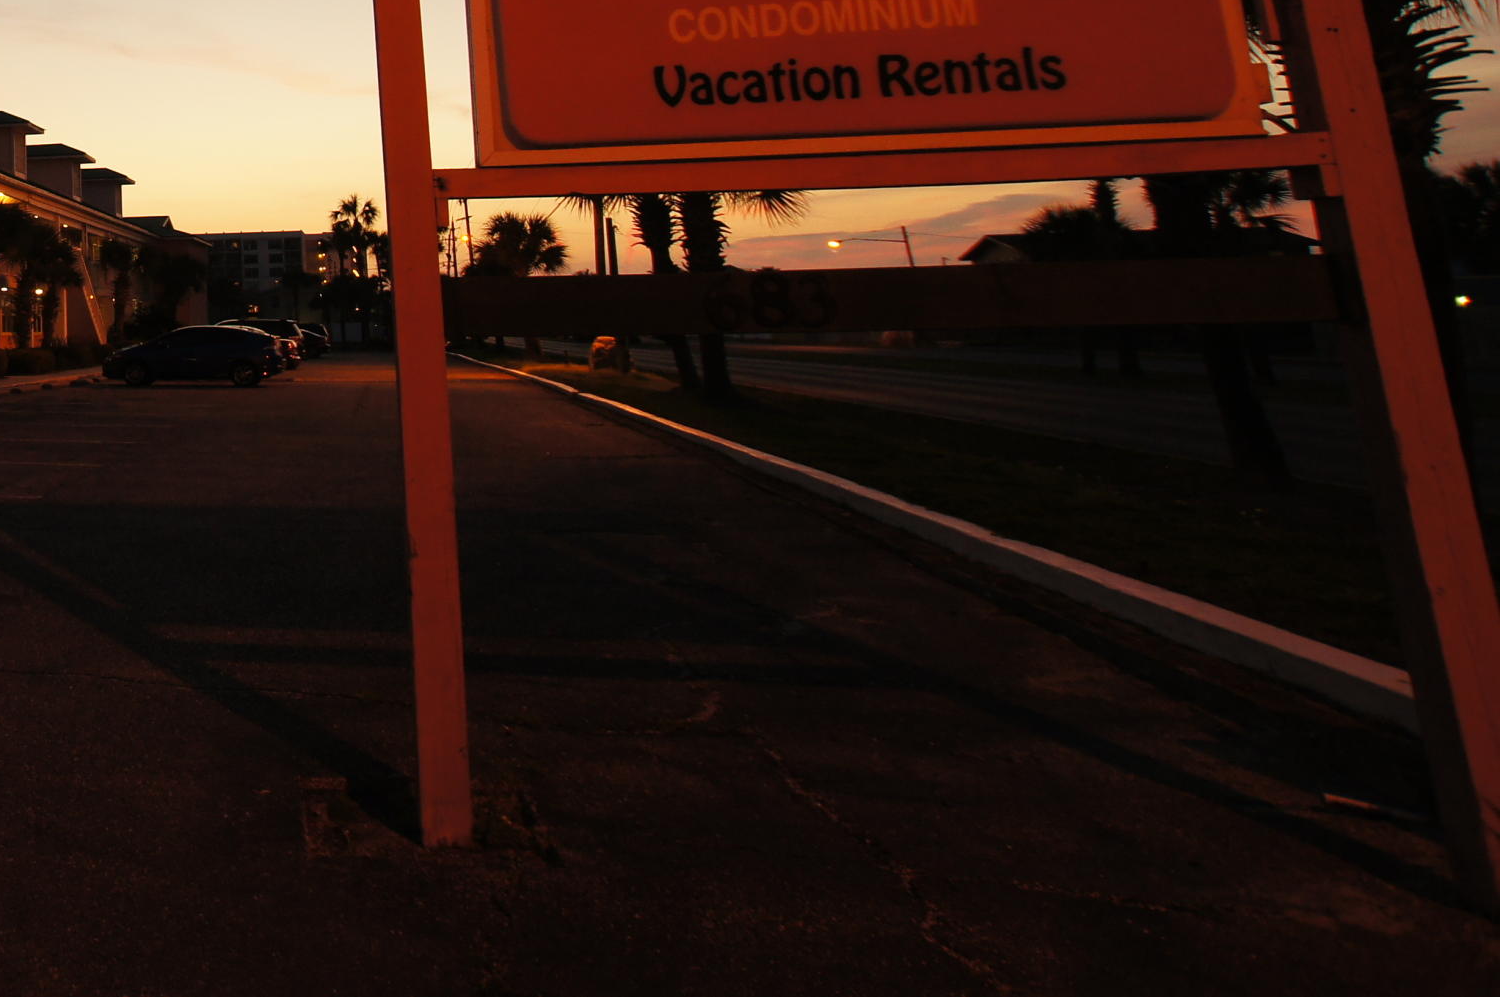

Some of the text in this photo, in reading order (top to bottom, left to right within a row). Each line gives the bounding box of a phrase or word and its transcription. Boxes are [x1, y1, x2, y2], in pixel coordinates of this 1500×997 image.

[653, 46, 1066, 108] Vacation Rentals
[704, 268, 838, 331] 683
